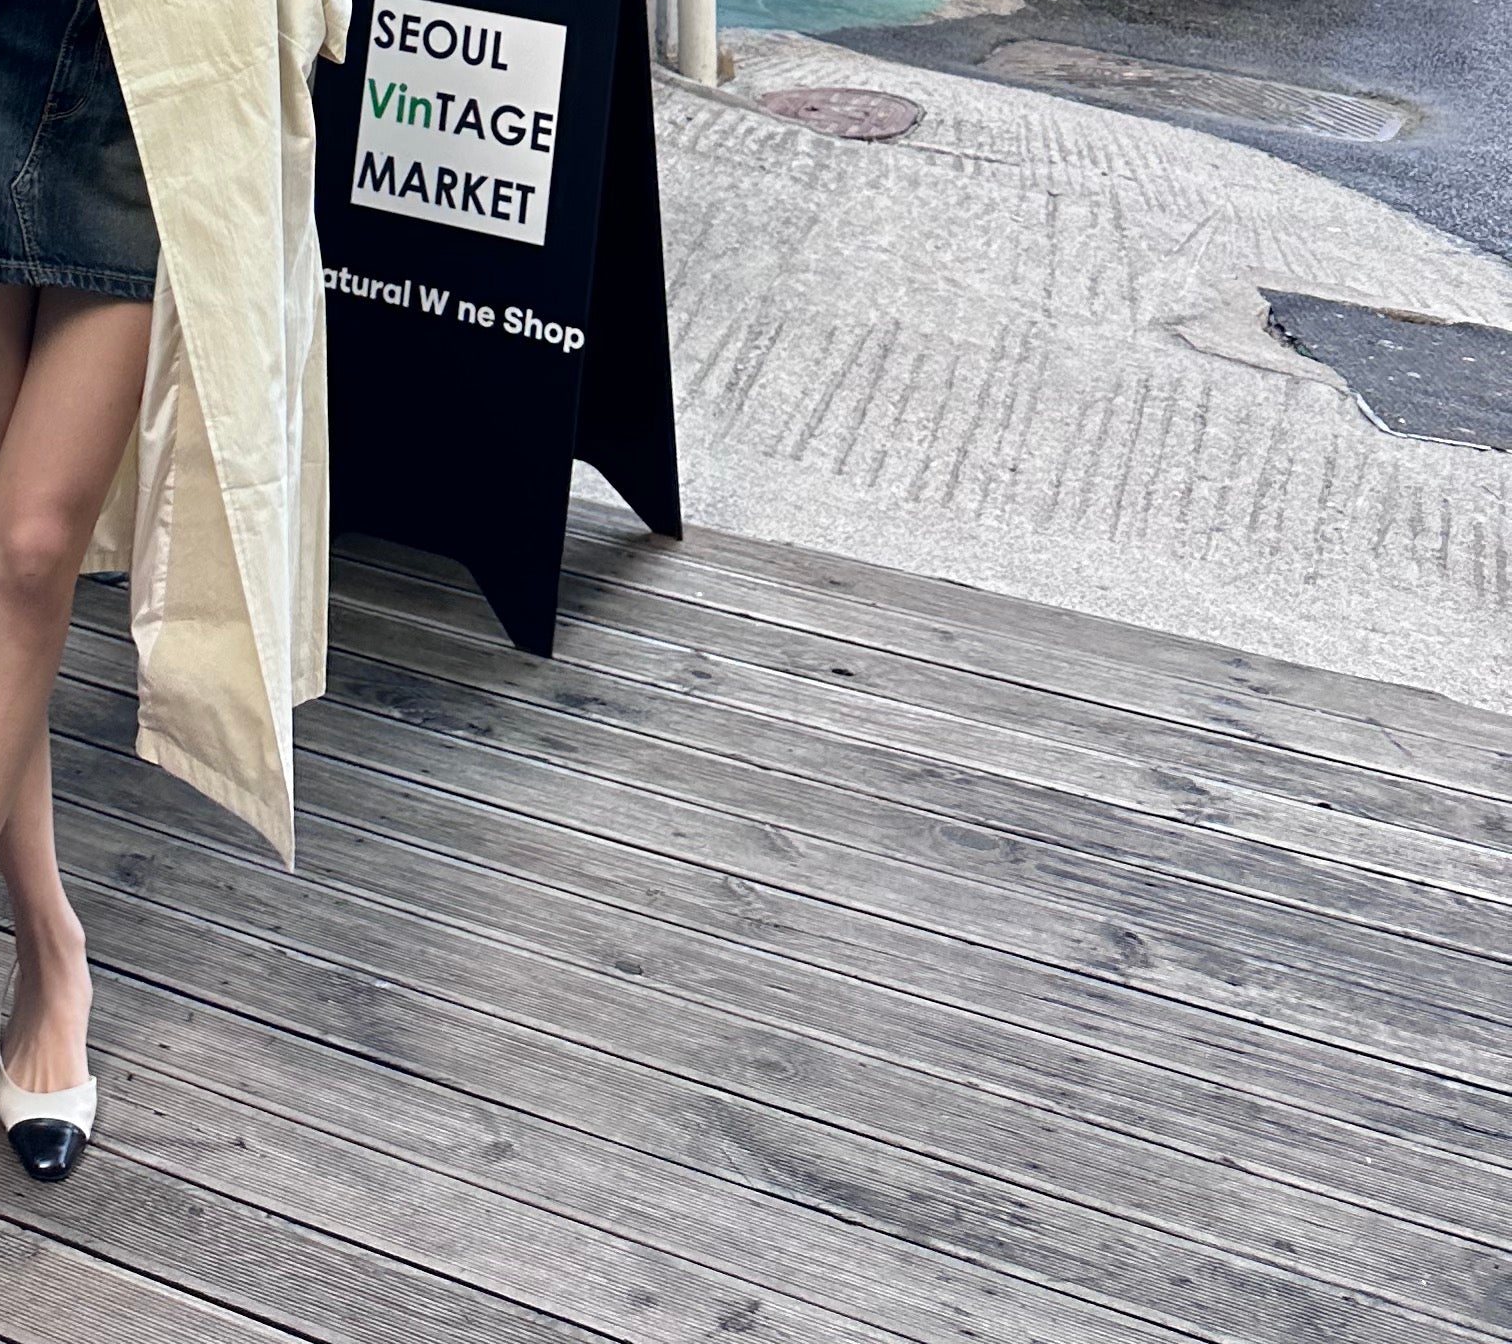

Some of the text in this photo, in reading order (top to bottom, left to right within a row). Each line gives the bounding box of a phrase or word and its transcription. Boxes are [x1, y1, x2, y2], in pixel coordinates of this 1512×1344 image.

[373, 10, 508, 71] SEOUL
[368, 77, 555, 153] VinTAGE
[356, 151, 536, 226] MARKET
[323, 266, 412, 308] atural
[502, 306, 585, 354] Shop
